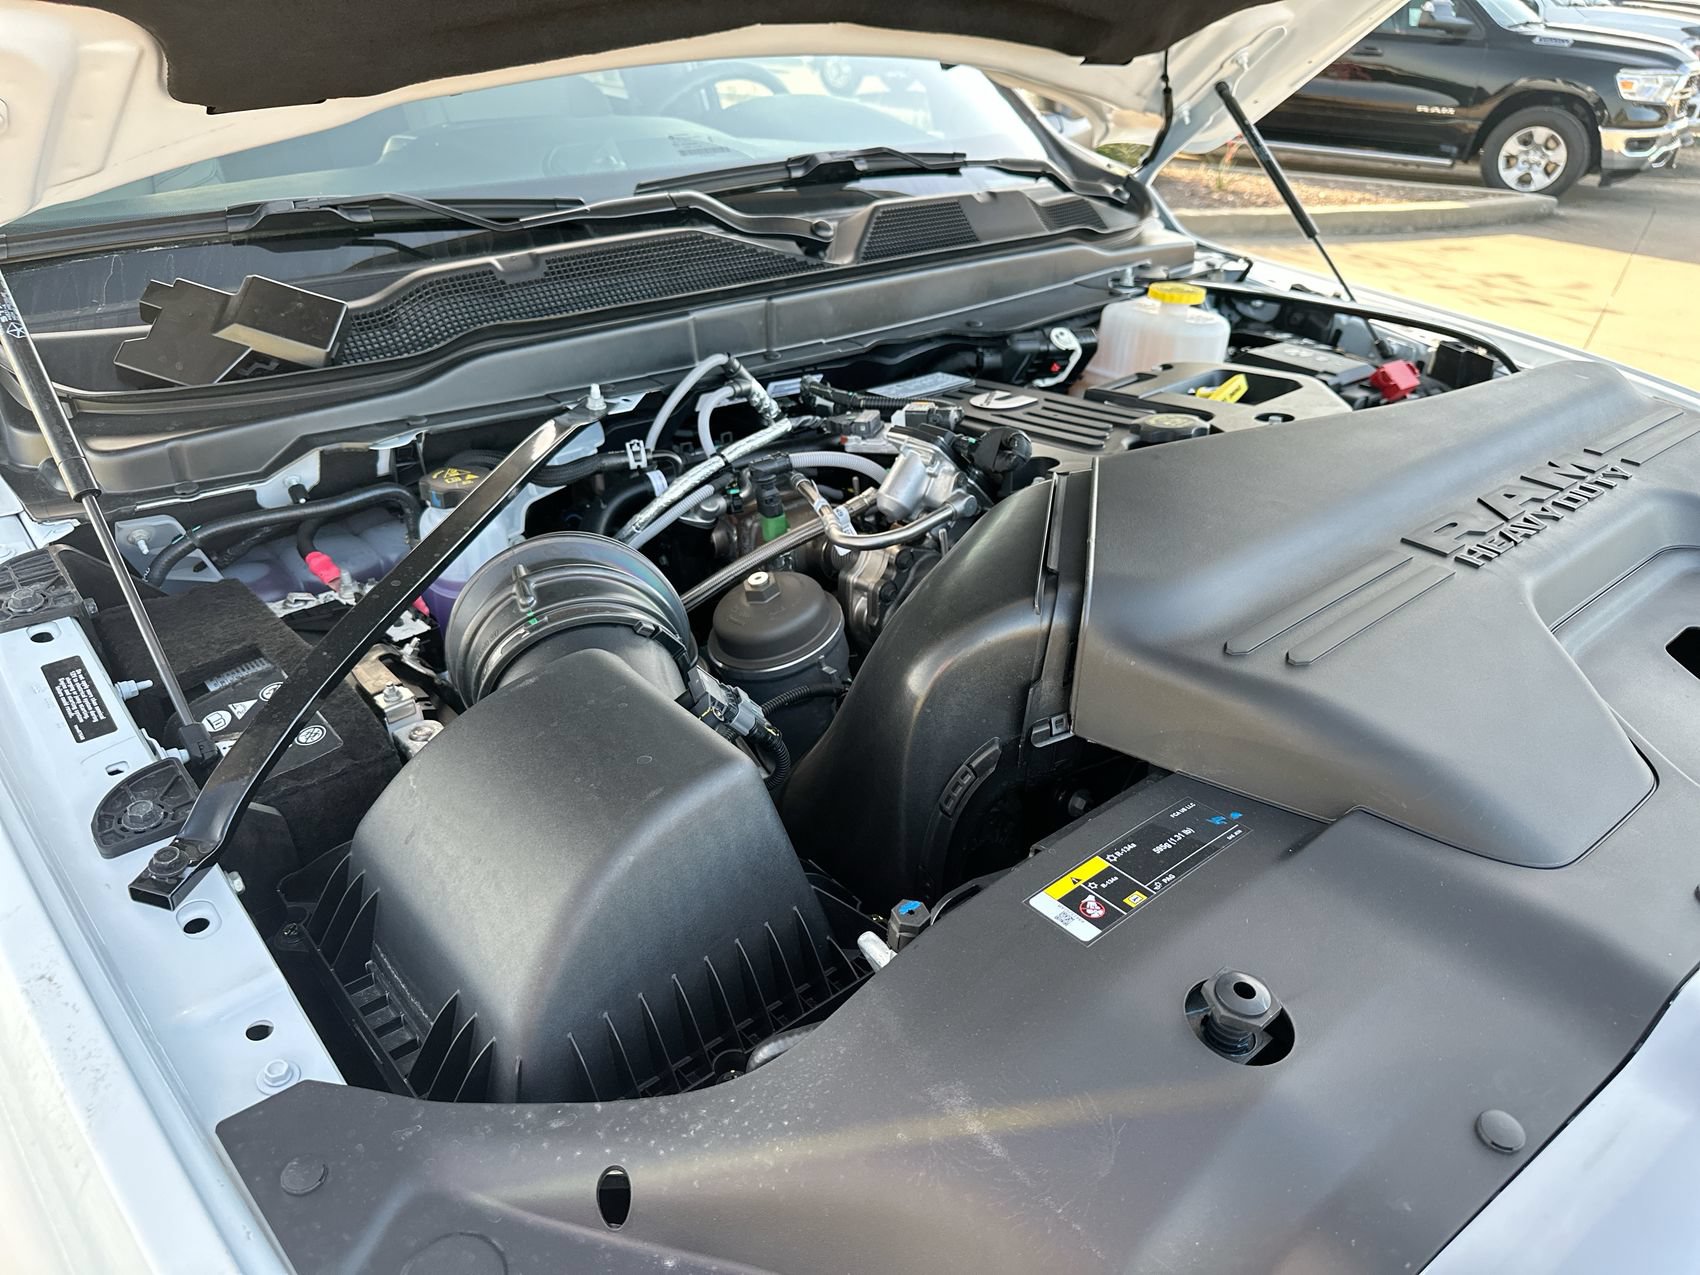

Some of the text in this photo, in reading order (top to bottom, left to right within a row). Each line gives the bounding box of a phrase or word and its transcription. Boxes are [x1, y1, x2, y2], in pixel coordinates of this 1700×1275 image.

[1416, 104, 1456, 115] RAM
[1400, 453, 1608, 557] RAM
[1454, 465, 1632, 568] HEAVY DUTY
[1114, 842, 1137, 857] R-134a
[1152, 826, 1195, 854] 595g (1.31 lb)
[1162, 873, 1176, 884] PAG
